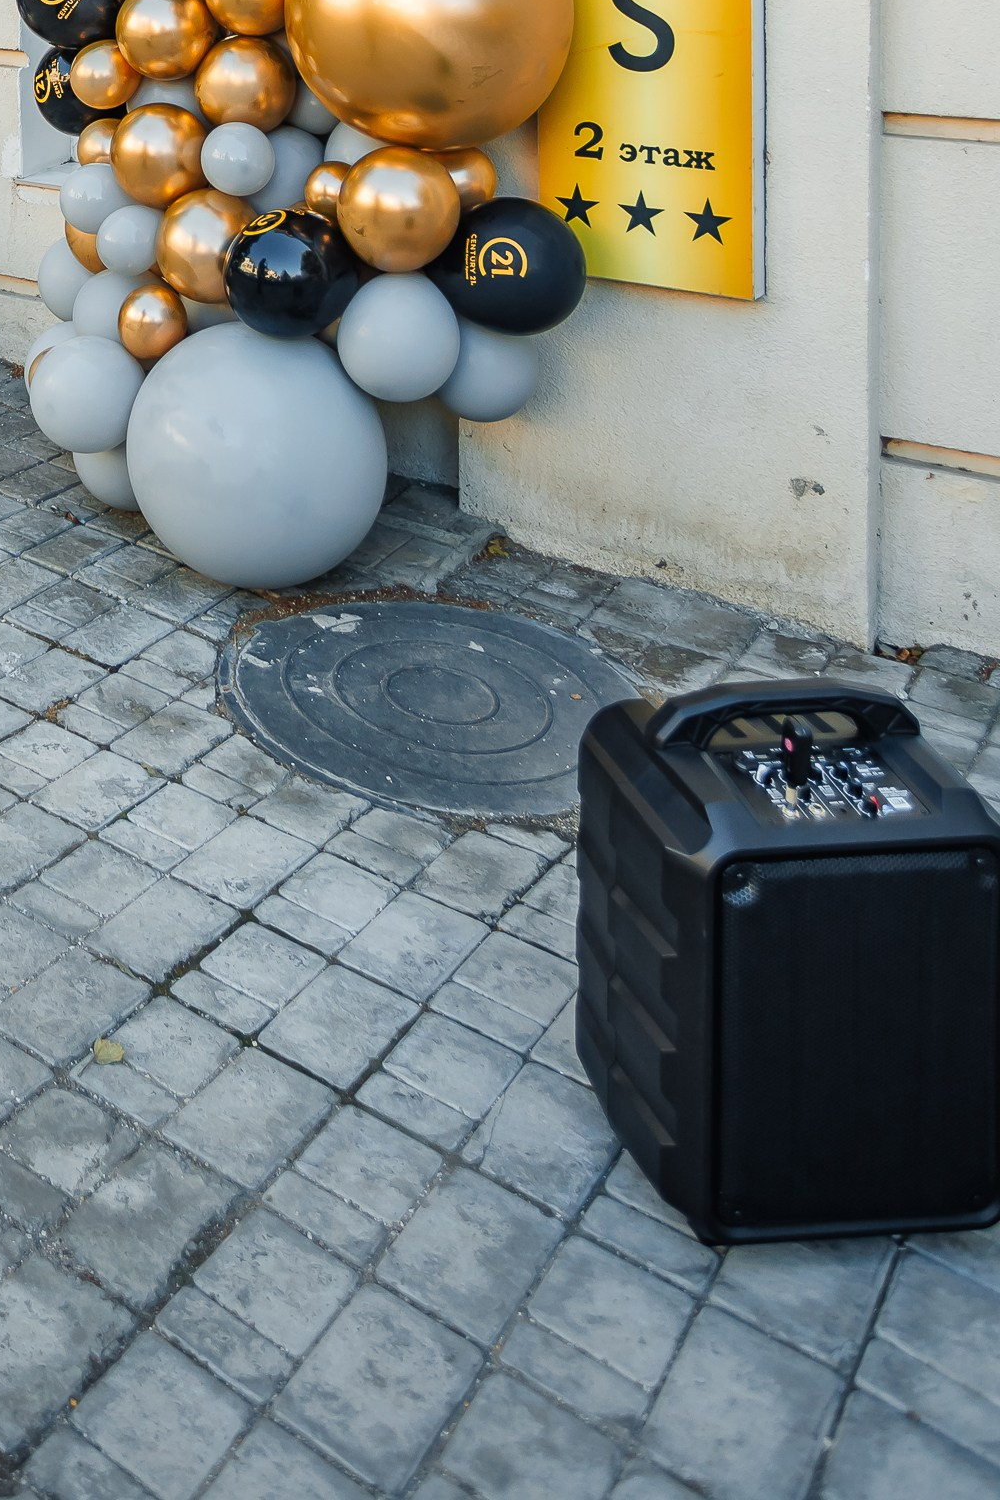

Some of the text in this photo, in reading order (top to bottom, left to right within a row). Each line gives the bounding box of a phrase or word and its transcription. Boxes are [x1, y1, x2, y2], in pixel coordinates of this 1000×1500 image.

[573, 121, 716, 171] 2 этаж
[469, 233, 477, 274] CENTURY
[491, 249, 514, 278] 21
